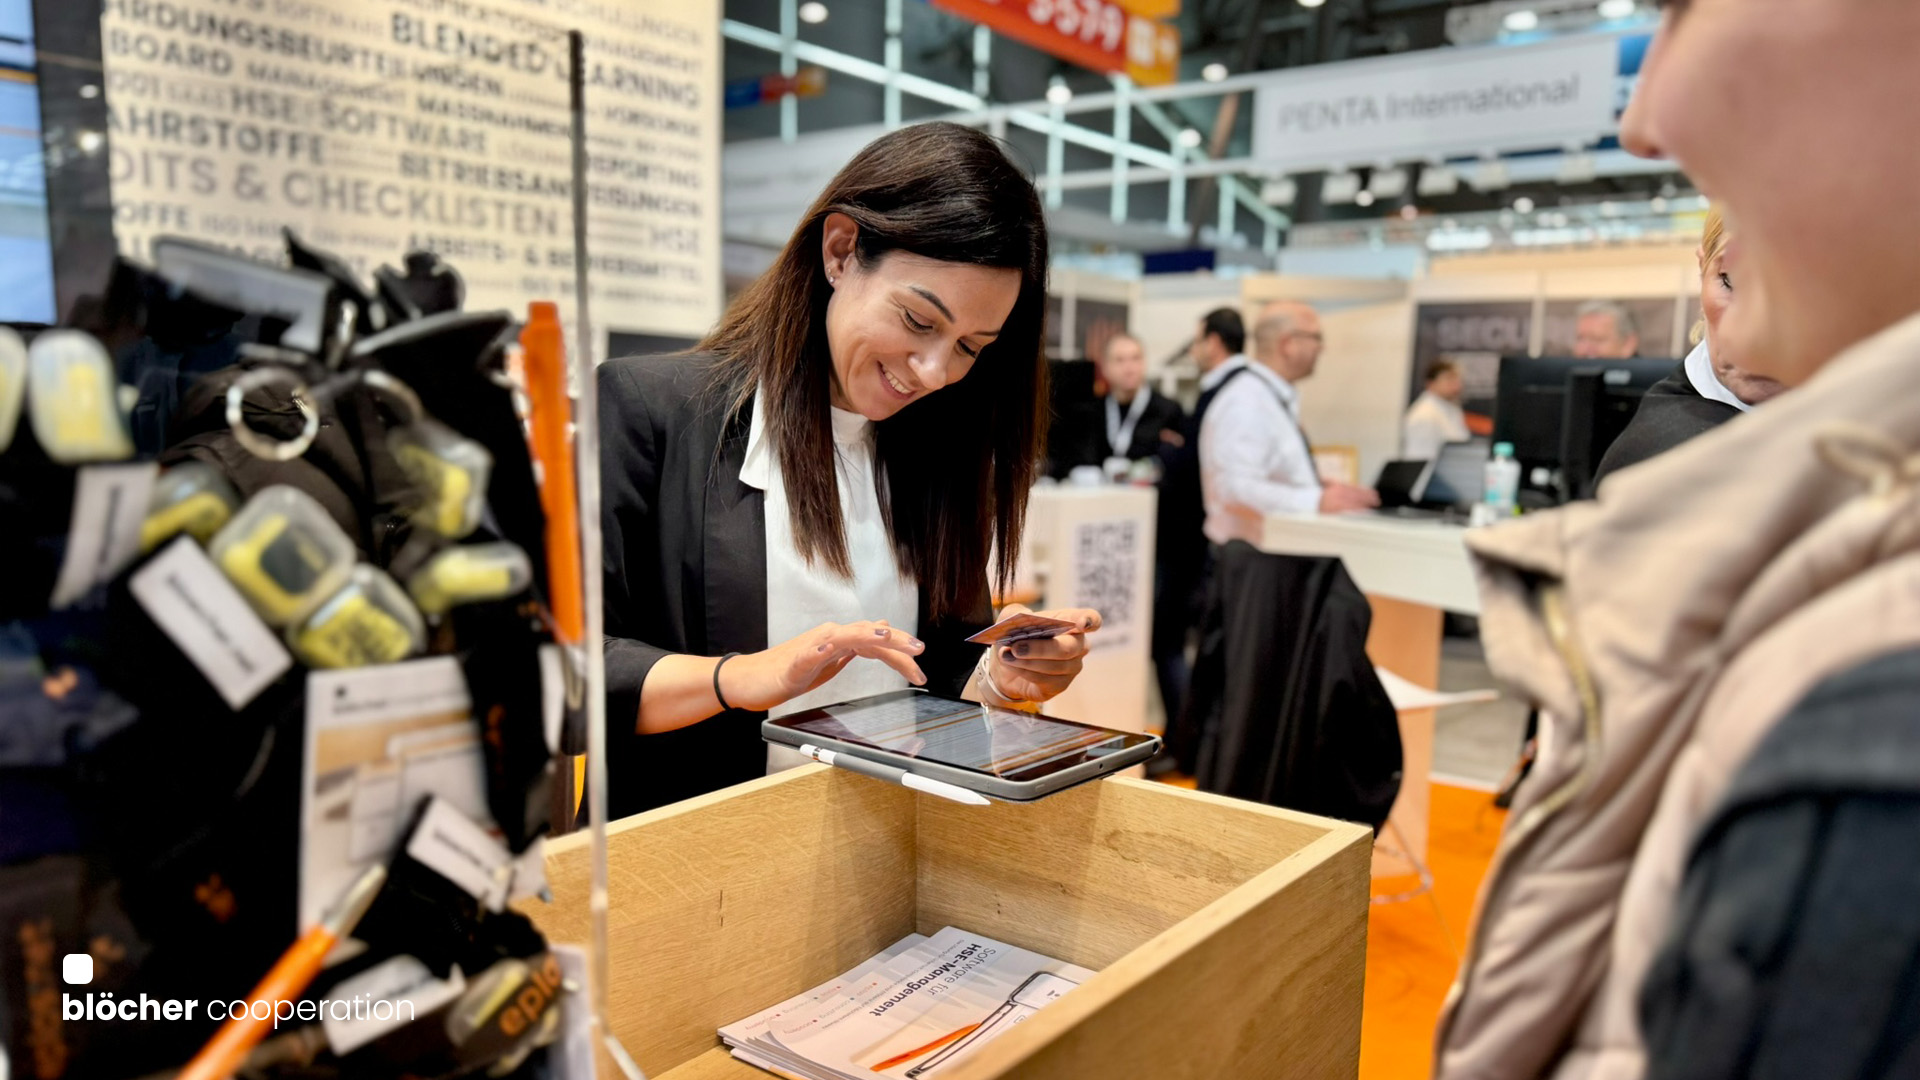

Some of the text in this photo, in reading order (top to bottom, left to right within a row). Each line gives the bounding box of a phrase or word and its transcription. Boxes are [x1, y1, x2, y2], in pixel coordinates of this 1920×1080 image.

[391, 12, 547, 74] BLENDED
[556, 52, 700, 109] LARNING
[319, 97, 488, 152] SOFTWARE
[1277, 72, 1580, 131] PENTA International
[232, 161, 267, 202] &
[283, 170, 559, 236] CHECKLISTEN
[868, 943, 982, 1017] HSE-Management
[944, 946, 996, 984] Software
